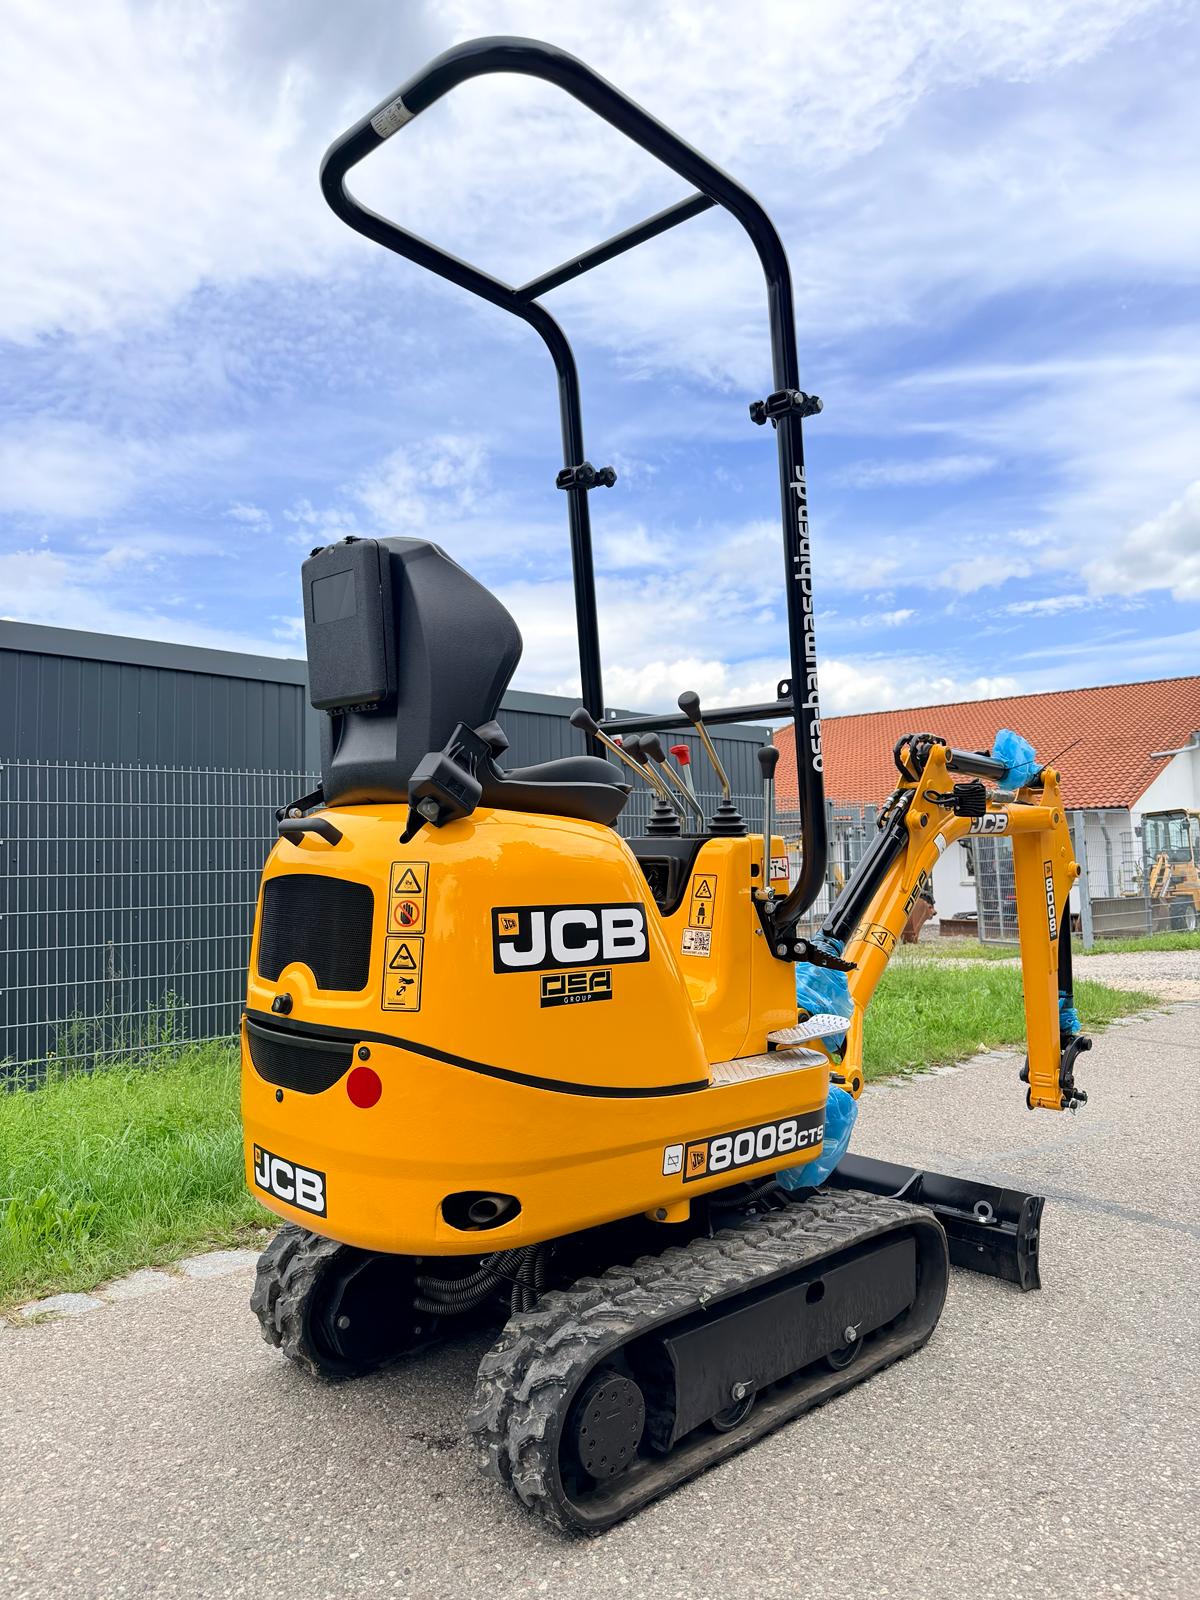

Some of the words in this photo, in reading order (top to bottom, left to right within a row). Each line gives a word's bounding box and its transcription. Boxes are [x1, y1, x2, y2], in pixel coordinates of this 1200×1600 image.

[789, 465, 824, 772] osa-baumaschinende
[970, 813, 1008, 834] JCB
[1045, 878, 1057, 932] 8008
[499, 908, 646, 967] JCB
[563, 994, 592, 1004] GROUP
[255, 1152, 325, 1212] JCB
[690, 1151, 704, 1170] JCB
